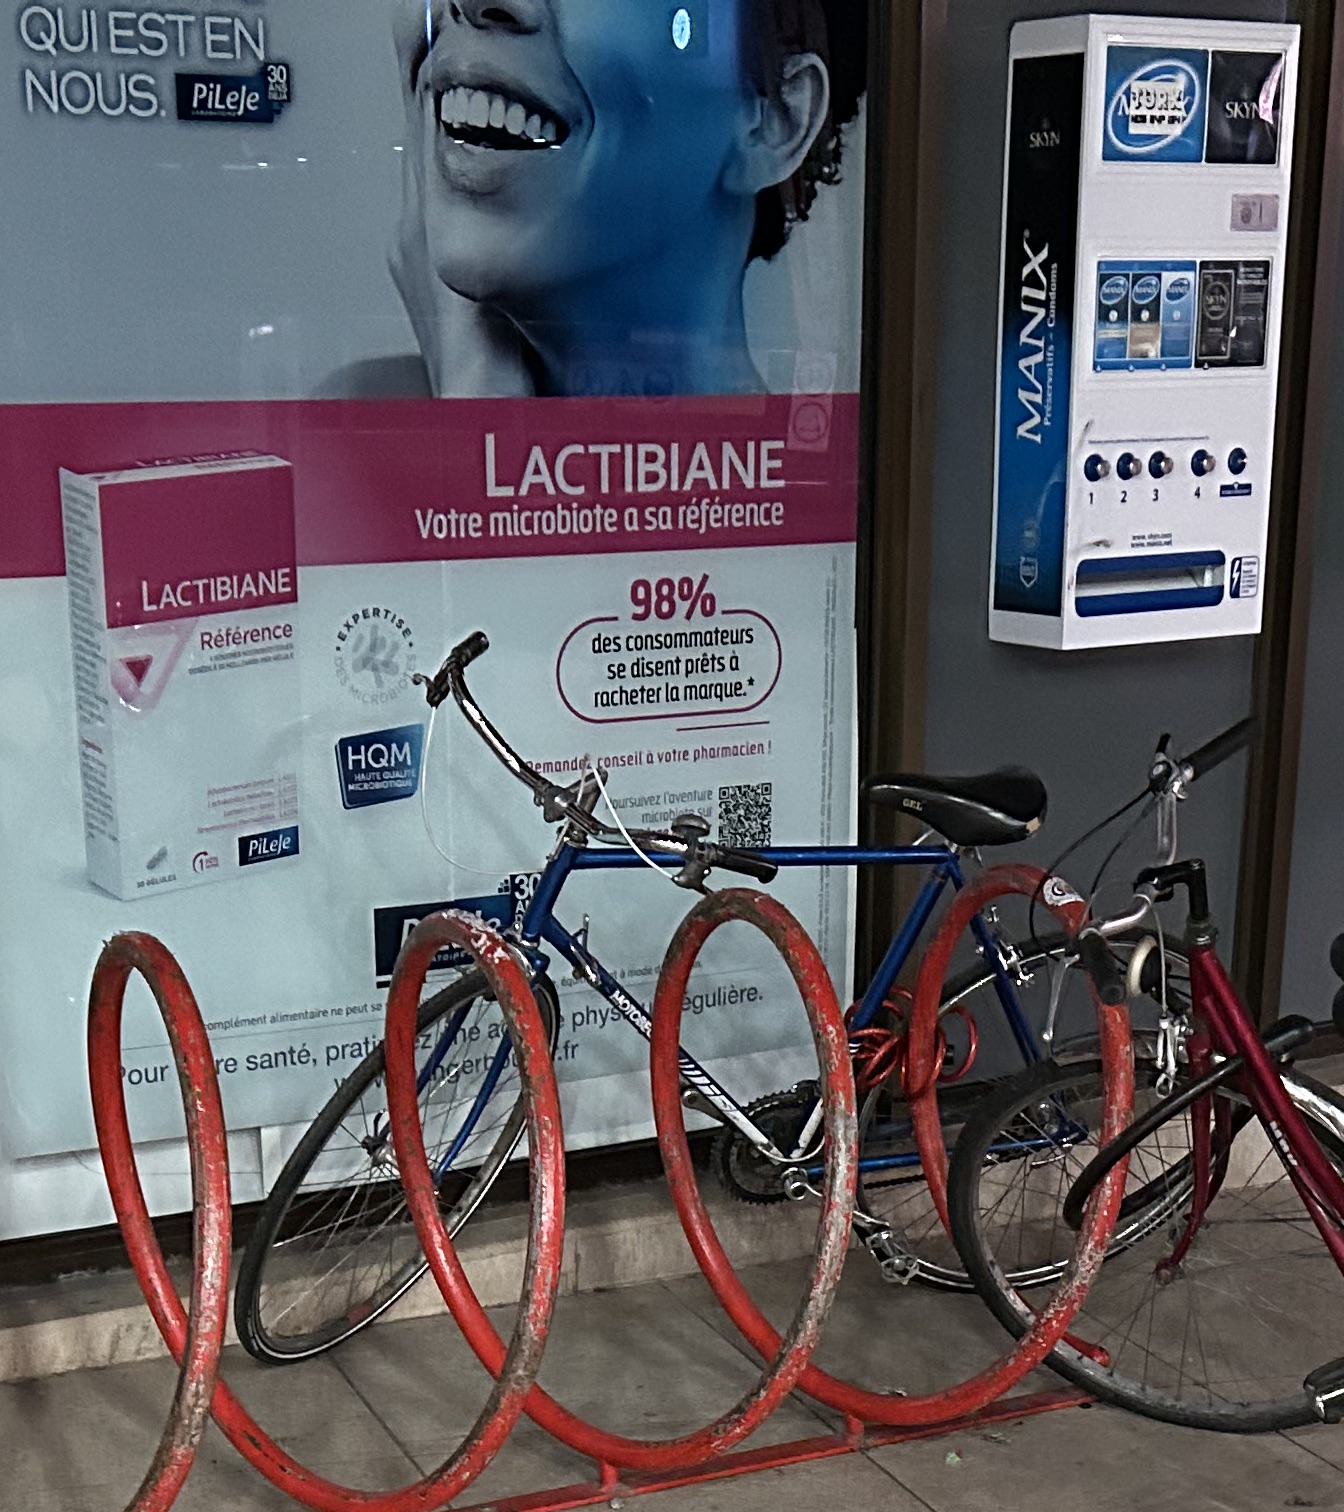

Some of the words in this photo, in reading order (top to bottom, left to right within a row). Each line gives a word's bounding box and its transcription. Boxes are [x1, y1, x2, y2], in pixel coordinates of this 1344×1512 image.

[20, 6, 98, 56] QUI
[109, 11, 196, 57] EST
[205, 16, 266, 62] EN
[267, 65, 287, 83] 30
[24, 69, 167, 118] NOUS.
[192, 82, 260, 116] PiLeJe
[1029, 131, 1060, 149] SKYN
[1017, 238, 1049, 445] MANIX
[484, 432, 787, 498] LACTIBIANE
[1120, 490, 1128, 503] 2
[1152, 488, 1159, 501] 3
[1194, 486, 1201, 499] 4
[415, 508, 483, 539] Votre
[488, 502, 619, 537] microbiote
[623, 509, 640, 533] a
[644, 505, 674, 532] sa
[677, 497, 785, 534] référence
[141, 567, 292, 612] LACTIBIANE
[629, 573, 717, 622] 98%
[200, 622, 294, 651] Référence
[337, 606, 413, 643] EXPERTISE
[591, 633, 622, 655] des
[625, 627, 754, 652] consommateurs
[607, 663, 626, 680] se
[630, 656, 682, 679] disent
[685, 652, 726, 676] prêts
[729, 650, 740, 673] à
[594, 683, 662, 708] racheter
[665, 682, 680, 702] la
[347, 742, 413, 771] HQM
[597, 751, 643, 769] conseil
[646, 750, 654, 764] à
[657, 747, 690, 763] votre
[693, 741, 765, 763] pharmacien
[247, 835, 292, 857] PiLeJe
[205, 1015, 267, 1032] omplément
[121, 1063, 169, 1086] our
[245, 1042, 318, 1072] santé,
